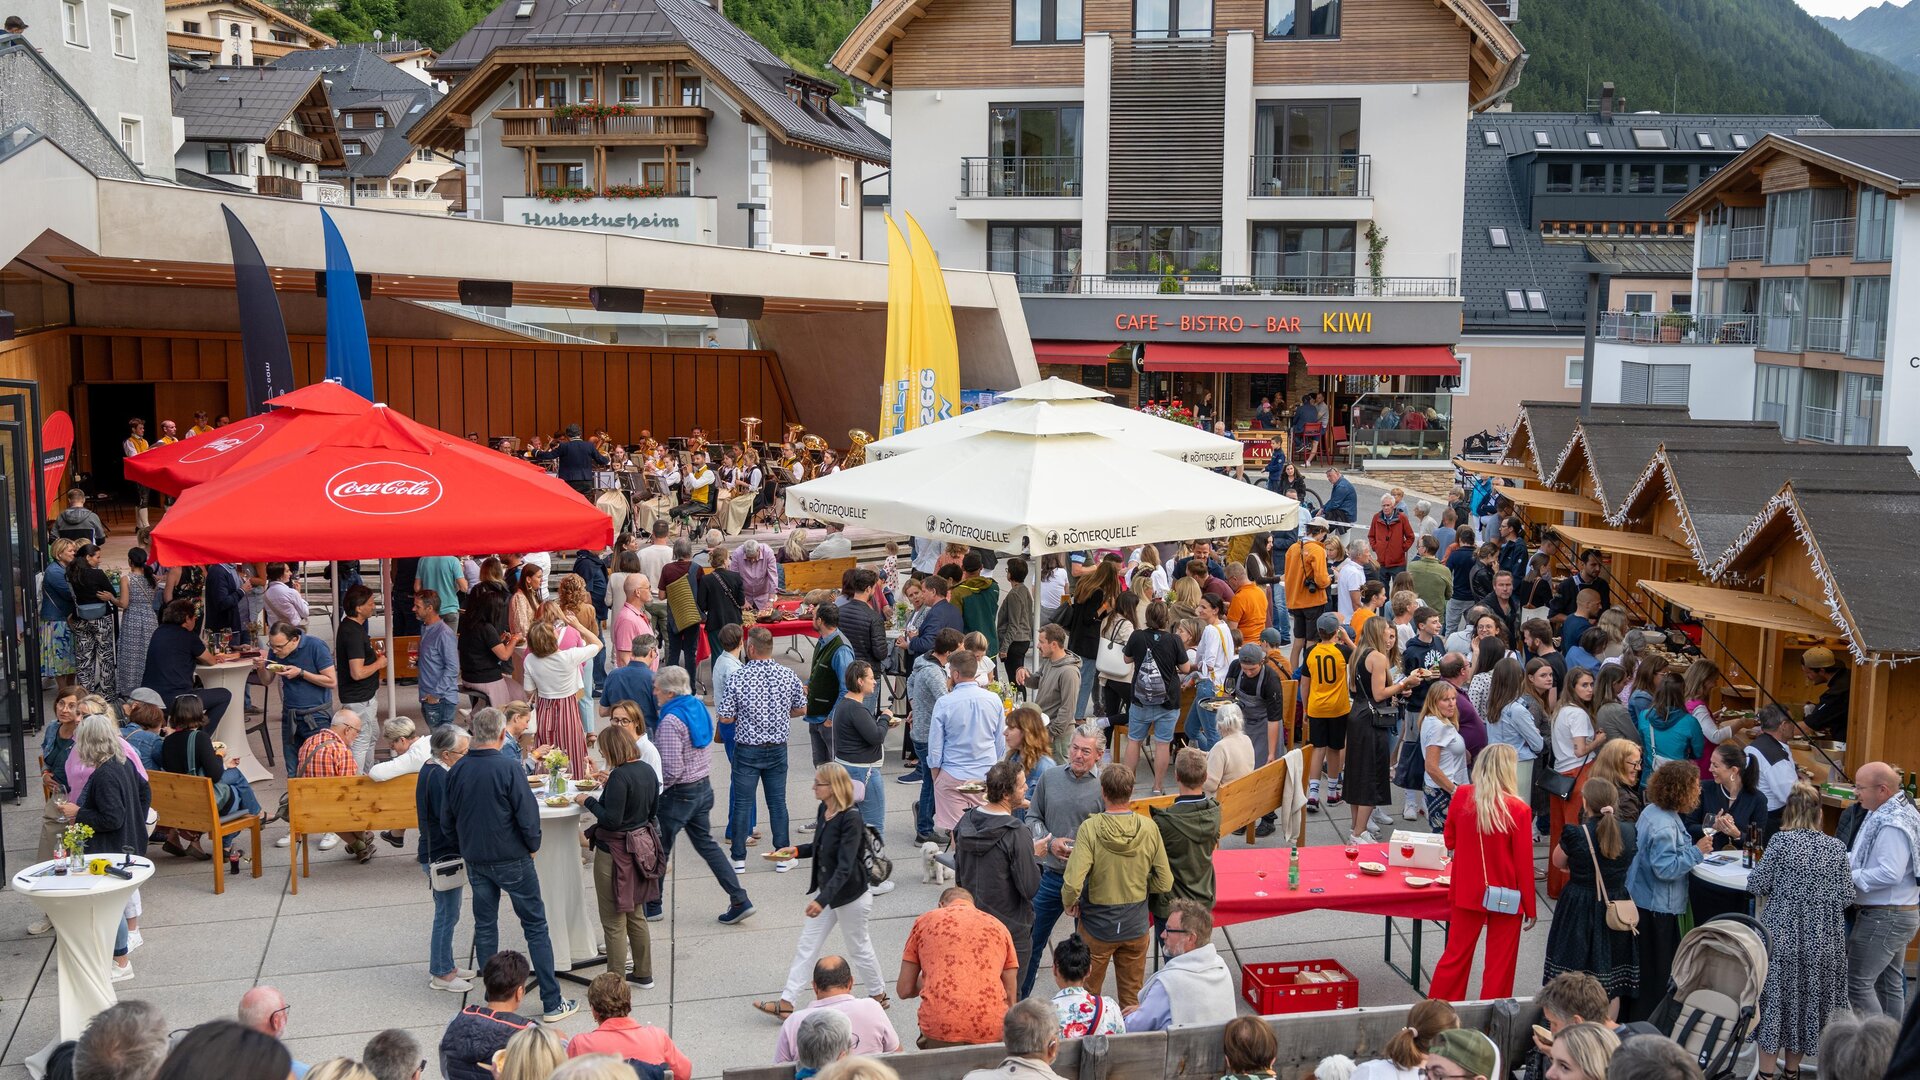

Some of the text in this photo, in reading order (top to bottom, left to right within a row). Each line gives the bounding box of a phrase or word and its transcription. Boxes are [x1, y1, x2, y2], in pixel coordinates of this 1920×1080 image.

[521, 212, 680, 229] Hubertusheim
[1115, 314, 1159, 331] CAFE
[1180, 315, 1244, 332] BISTRO
[1266, 317, 1302, 333] BAR
[1322, 312, 1372, 334] KIWI
[1252, 448, 1273, 457] KIW
[1315, 654, 1337, 684] 10
